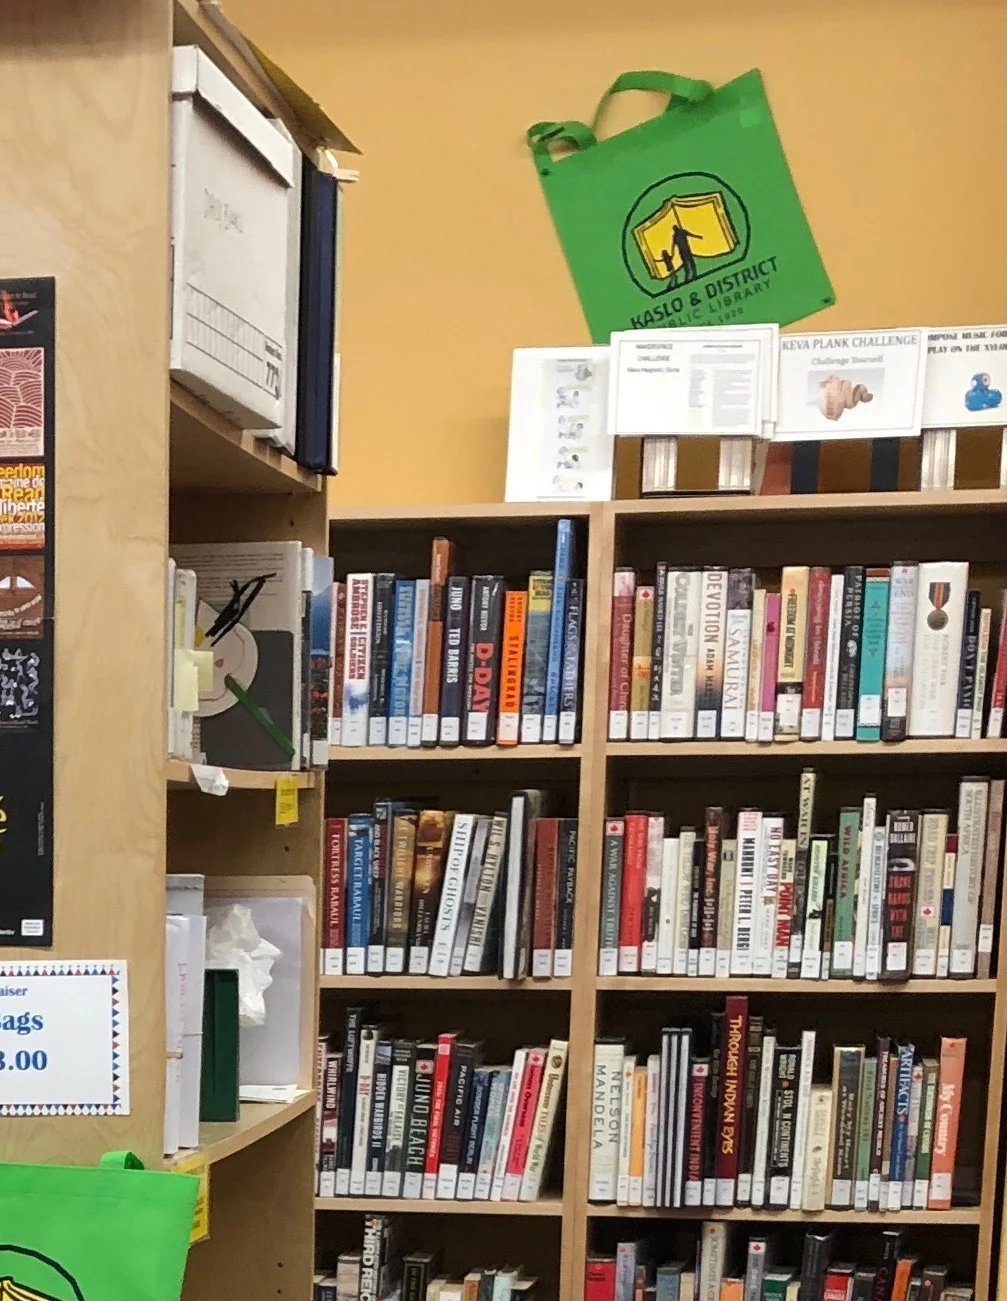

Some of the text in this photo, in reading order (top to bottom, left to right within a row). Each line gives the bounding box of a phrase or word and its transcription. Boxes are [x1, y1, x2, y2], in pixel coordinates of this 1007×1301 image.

[630, 297, 684, 330] KASLO
[689, 291, 702, 306] &
[704, 256, 778, 299] DISTRICT
[708, 278, 771, 313] LIBRARY
[782, 334, 918, 351] KEVA PLANK CHALLENGE
[811, 355, 884, 366] Challenge Yourself
[447, 586, 463, 684] JUNO TED BARRIS
[704, 573, 723, 671] DEVOTION ADAM
[357, 636, 367, 680] CITIZEN
[474, 642, 493, 713] D-DAY
[507, 635, 519, 708] STALINGRAD
[724, 628, 740, 711] SAMURAI
[329, 834, 341, 927] FORTRESS RABAUL
[440, 821, 468, 932] SHIP OF GHOSTS
[607, 848, 618, 913] WAR AGAINST
[739, 837, 755, 914] MANHUNT PETER
[765, 826, 782, 893] NO EASY DAY
[352, 881, 362, 923] RABAUL
[776, 882, 792, 947] POINT MAN
[325, 1060, 338, 1109] WHIRLWIND
[395, 1069, 407, 1103] VICTORY
[453, 1064, 467, 1127] PACIFIC AIR
[593, 1065, 606, 1150] MANDELA
[608, 1071, 622, 1143] NELSON
[721, 1014, 742, 1155] THROUGH INDIAN EYES
[897, 1048, 914, 1115] ARTIFACTS
[408, 1073, 430, 1166] JUNO BEACH
[934, 1084, 956, 1157] My Country
[363, 1219, 376, 1266] THIRD
